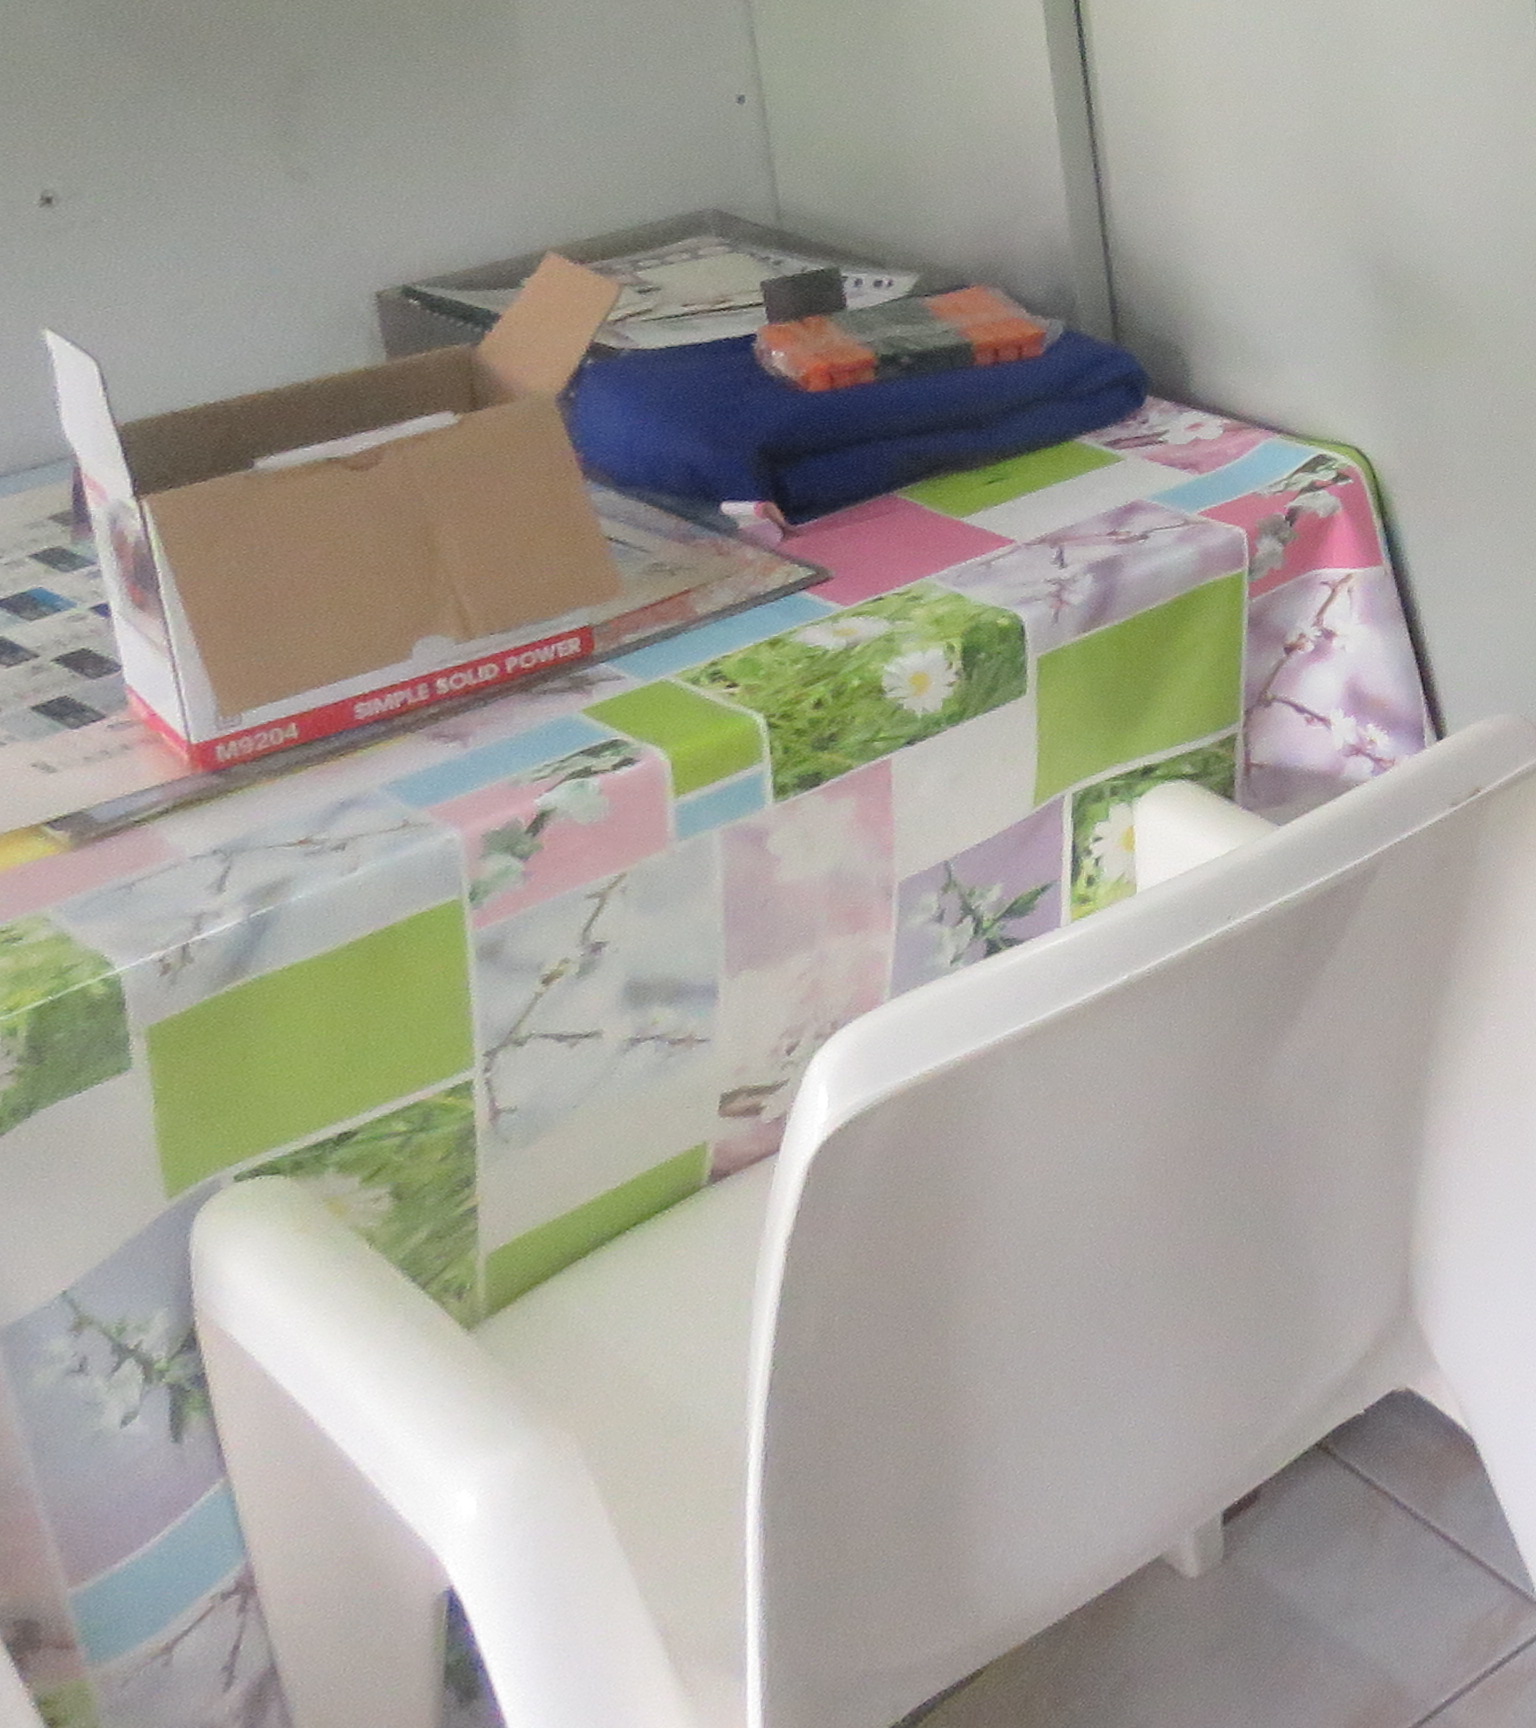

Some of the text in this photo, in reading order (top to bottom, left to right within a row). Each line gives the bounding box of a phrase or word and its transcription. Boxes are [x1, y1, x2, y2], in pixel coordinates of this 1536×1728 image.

[352, 635, 583, 721] SIMPLE SOLID POWER
[214, 722, 300, 763] M9204
